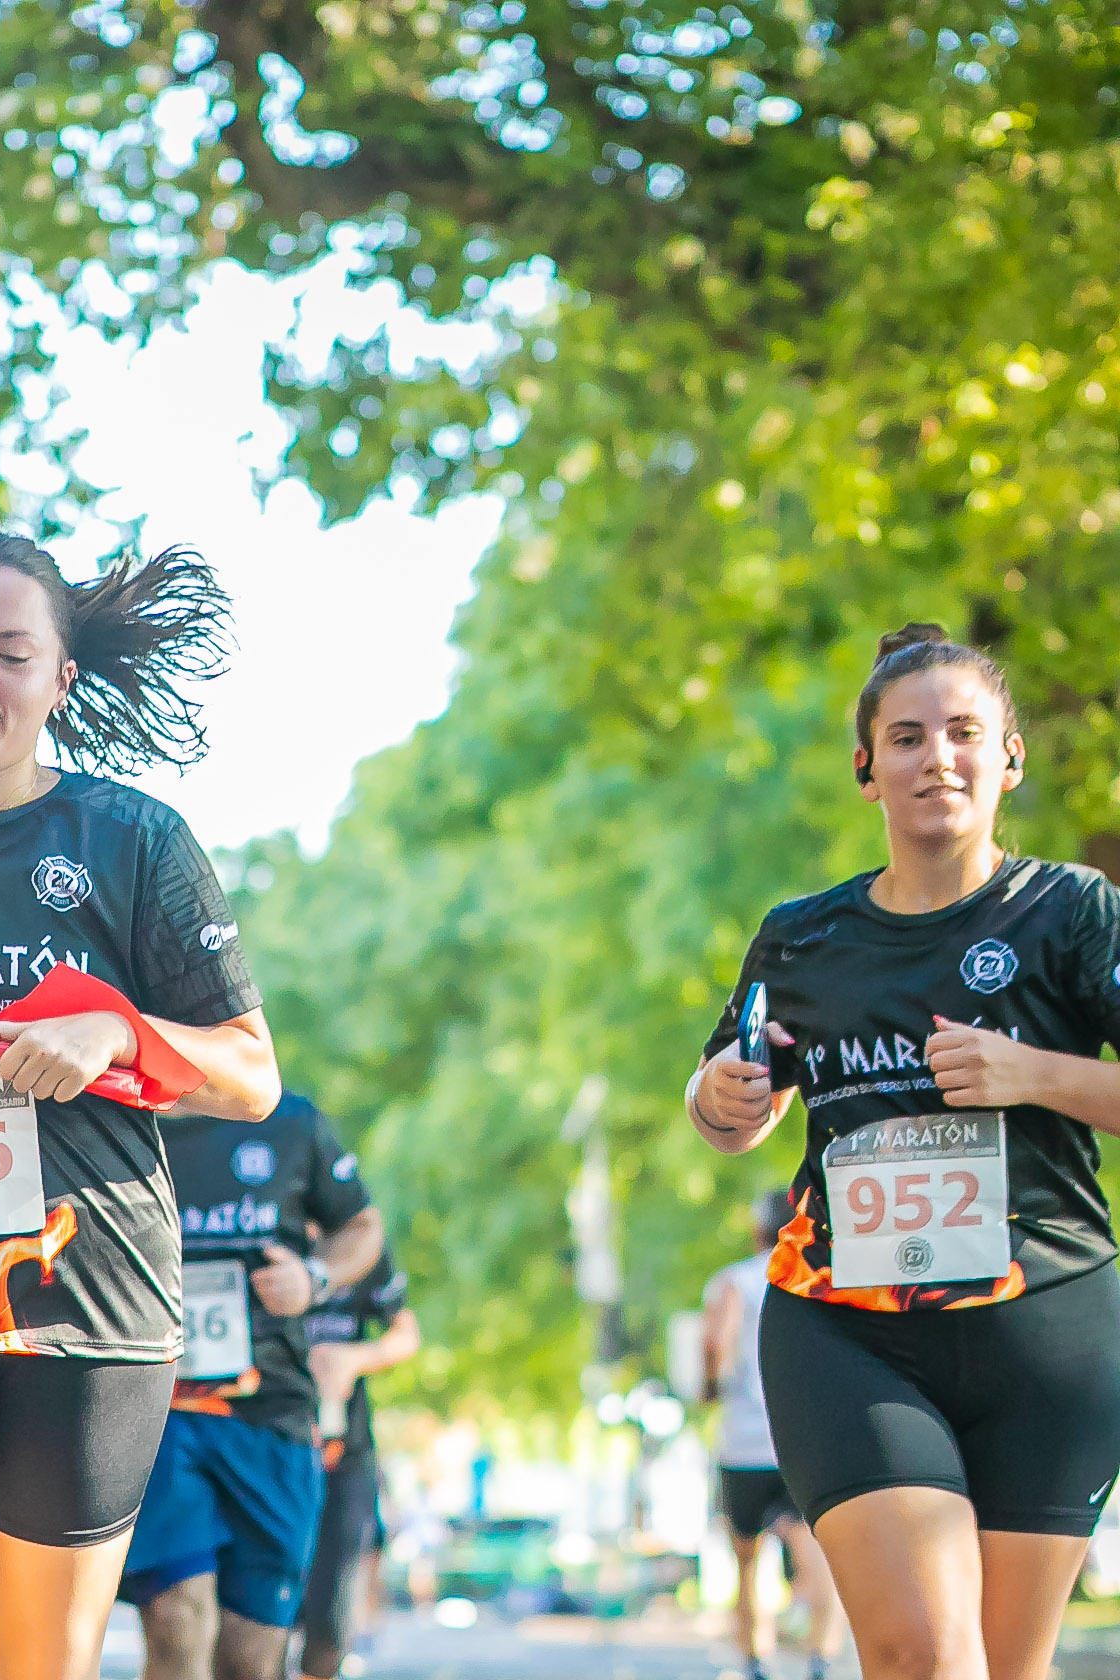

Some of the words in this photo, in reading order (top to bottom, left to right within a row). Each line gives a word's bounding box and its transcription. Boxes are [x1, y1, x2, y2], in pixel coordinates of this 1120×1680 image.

[51, 869, 74, 890] 27
[873, 1117, 979, 1151] MARATÓN
[846, 1170, 983, 1234] 952
